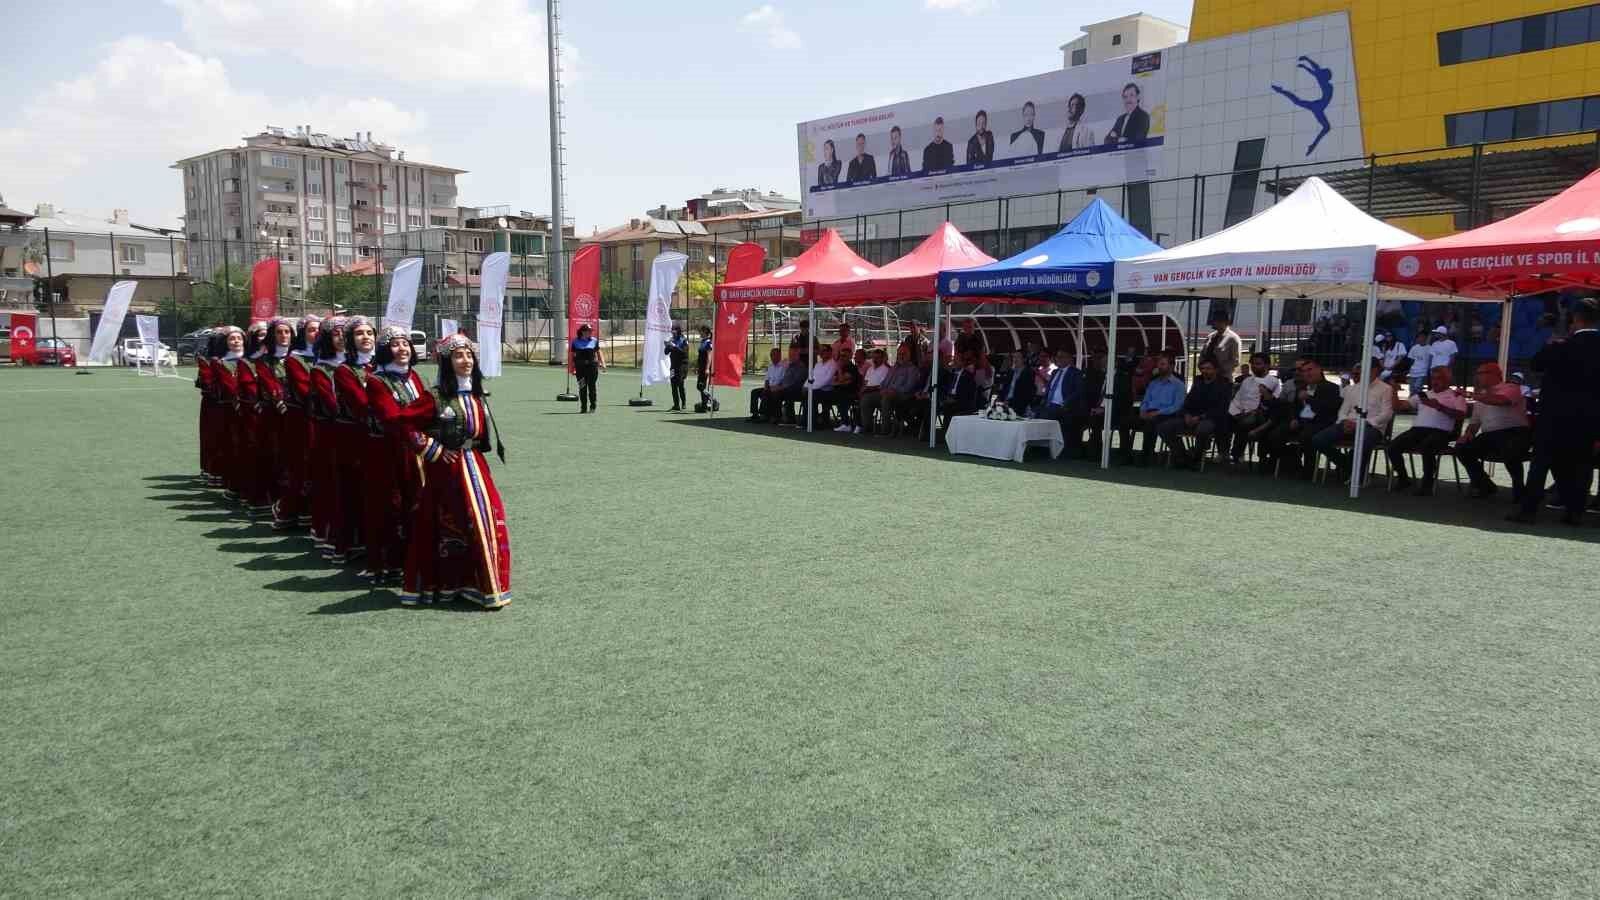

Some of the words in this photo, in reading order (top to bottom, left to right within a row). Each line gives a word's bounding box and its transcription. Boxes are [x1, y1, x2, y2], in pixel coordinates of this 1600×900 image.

[1436, 257, 1459, 270] VAN
[1462, 253, 1513, 271] GENÇLİK
[1517, 254, 1533, 267] VE
[1537, 252, 1573, 265] SPOR
[1577, 249, 1590, 265] İL
[1012, 275, 1028, 286] SPOR
[1153, 272, 1169, 283] VAN
[1205, 268, 1217, 279] VE
[1218, 266, 1242, 278] SPOR
